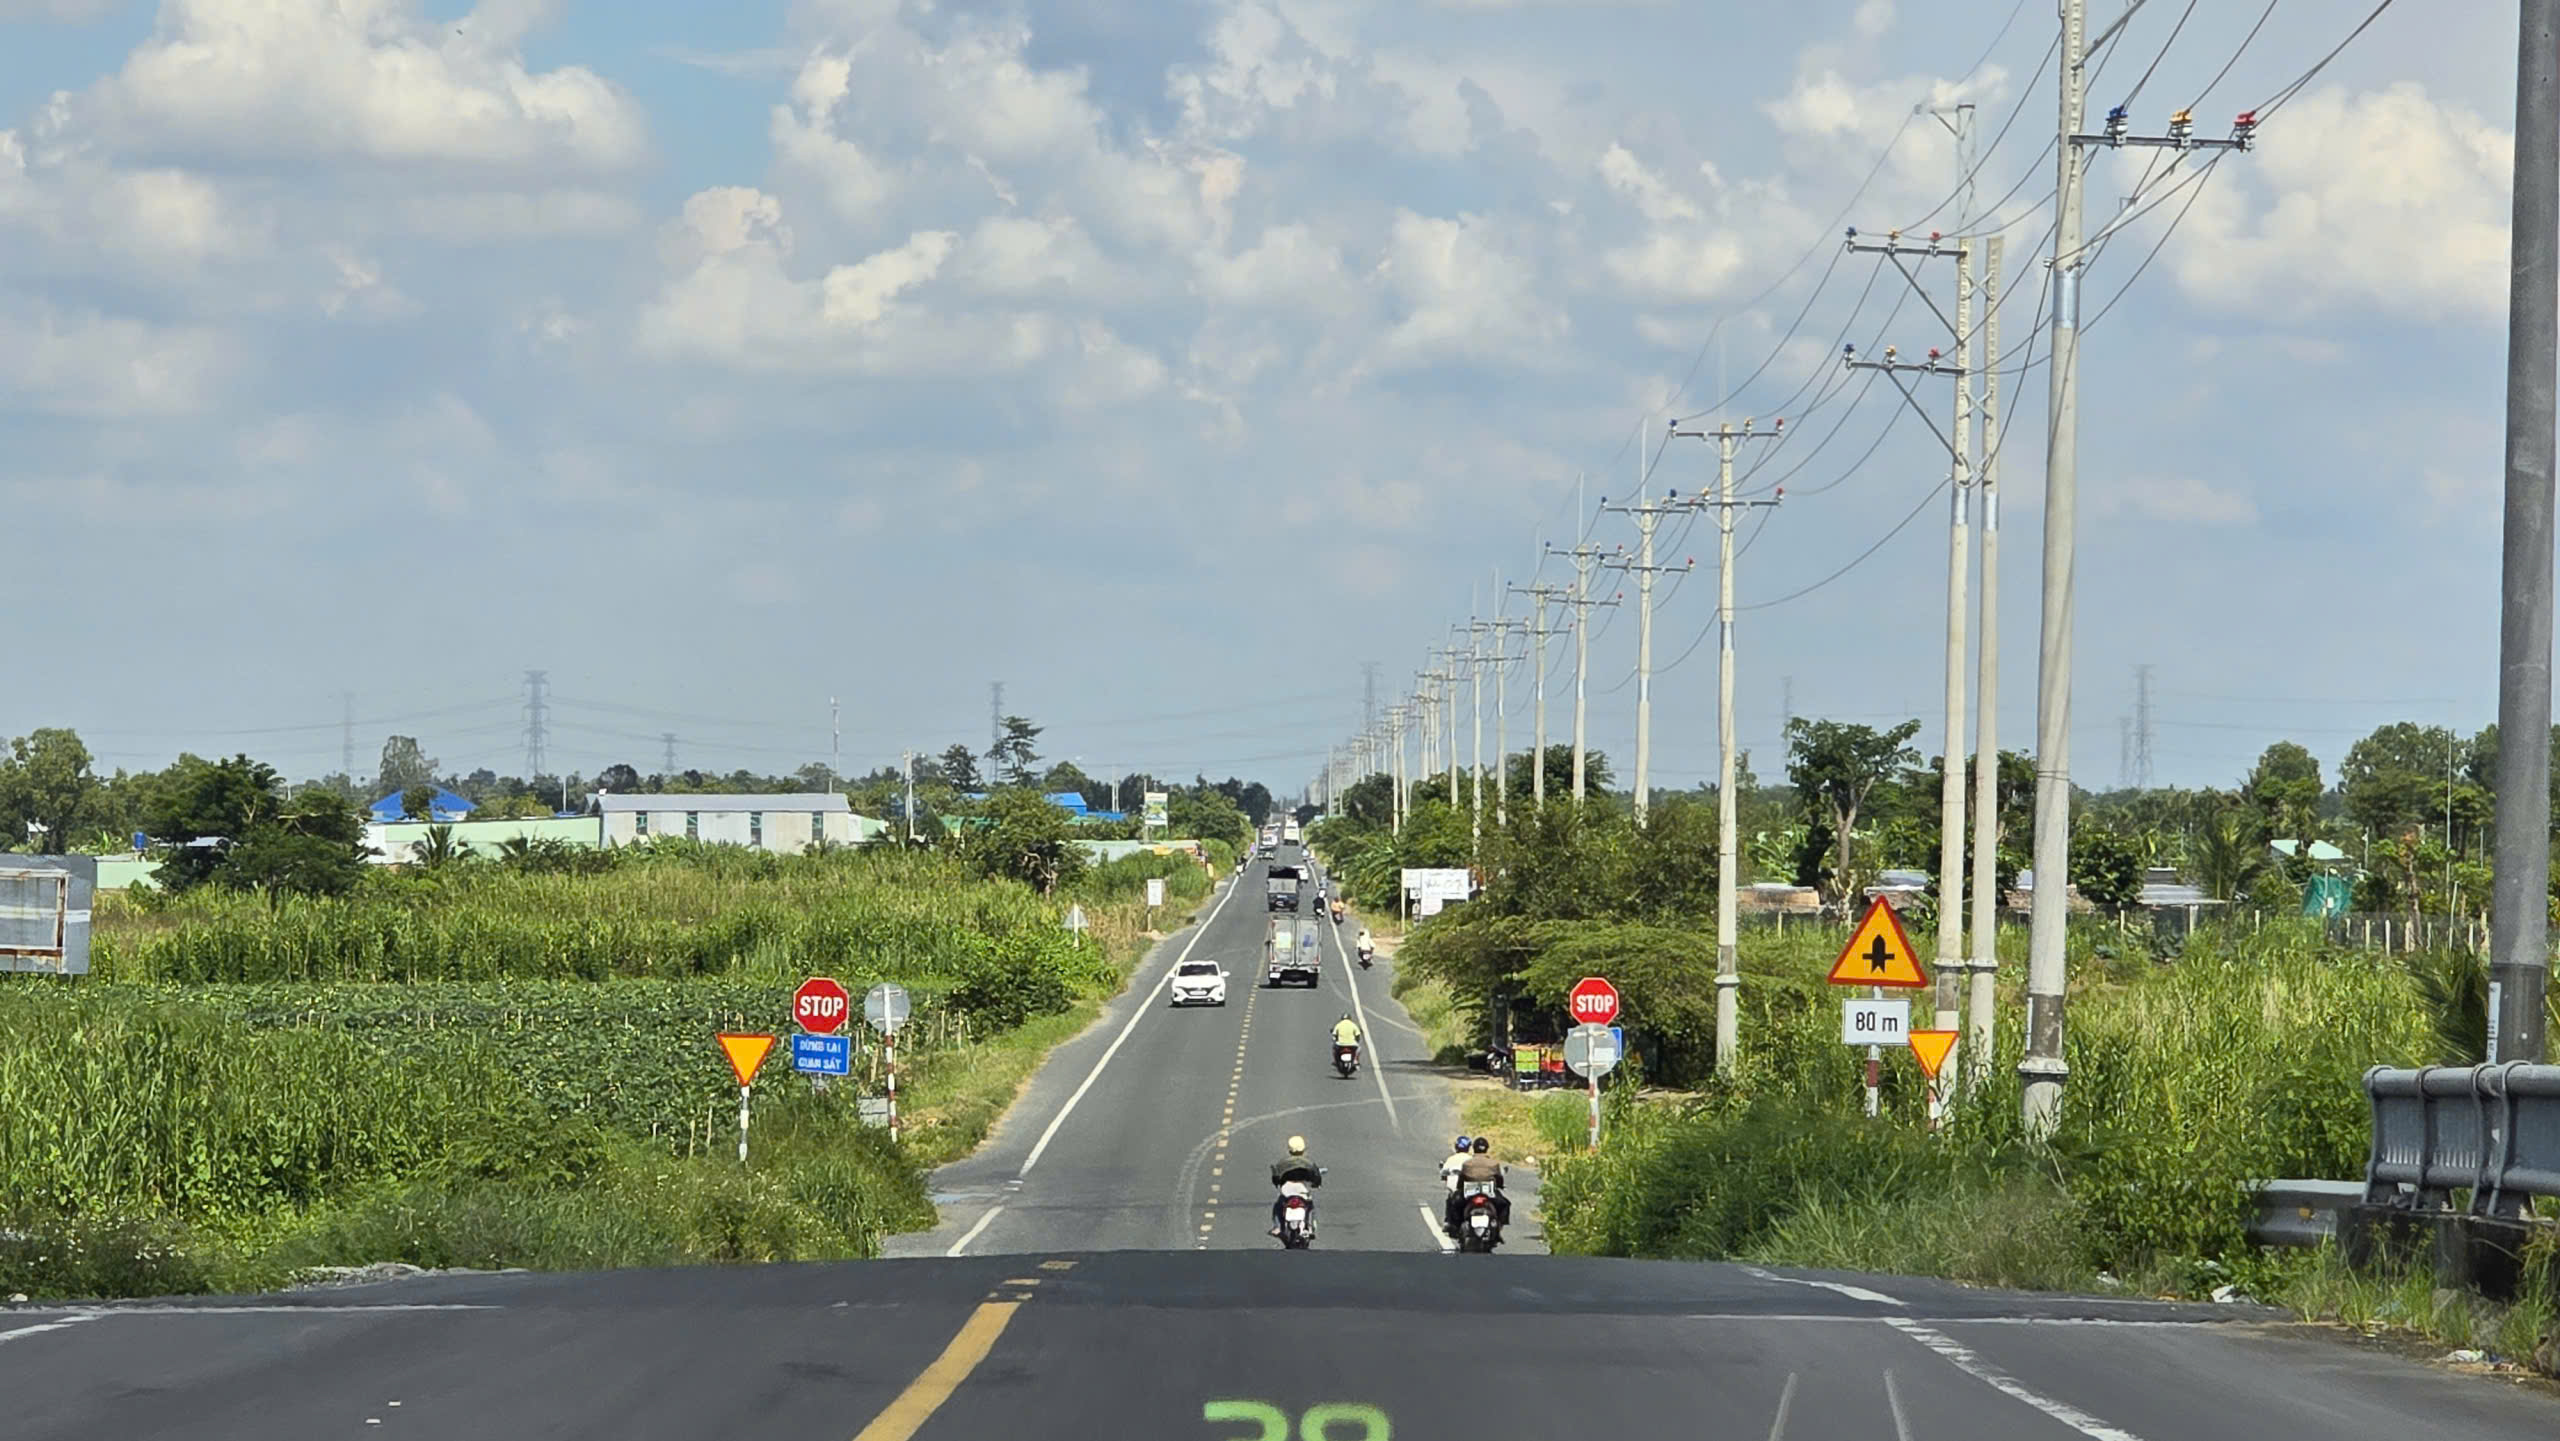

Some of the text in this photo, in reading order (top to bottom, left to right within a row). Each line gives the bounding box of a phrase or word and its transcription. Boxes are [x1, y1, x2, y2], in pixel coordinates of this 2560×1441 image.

[799, 995, 844, 1017] STOP
[1576, 994, 1614, 1013] STOP
[1855, 1012, 1898, 1032] 80 m
